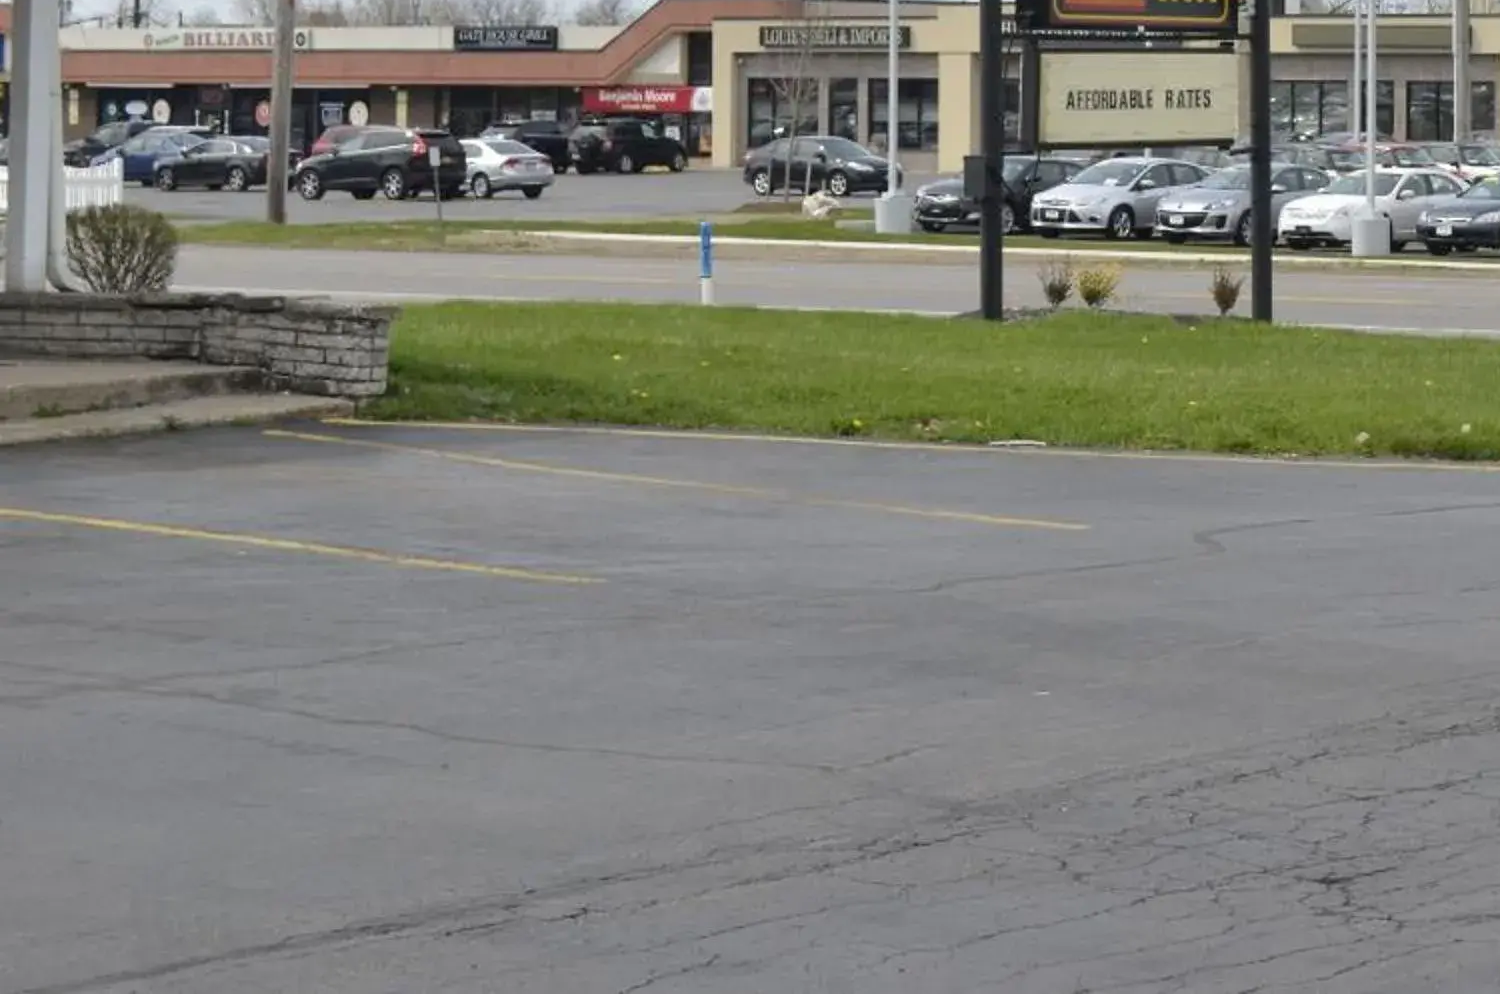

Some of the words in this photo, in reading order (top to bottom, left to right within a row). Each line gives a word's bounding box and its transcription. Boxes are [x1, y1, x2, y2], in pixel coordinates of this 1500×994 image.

[850, 28, 904, 46] IMPORS
[598, 87, 642, 105] Benjamin
[645, 87, 676, 103] Moore
[1066, 89, 1153, 110] AFFORDABLE
[1165, 89, 1212, 109] RATES
